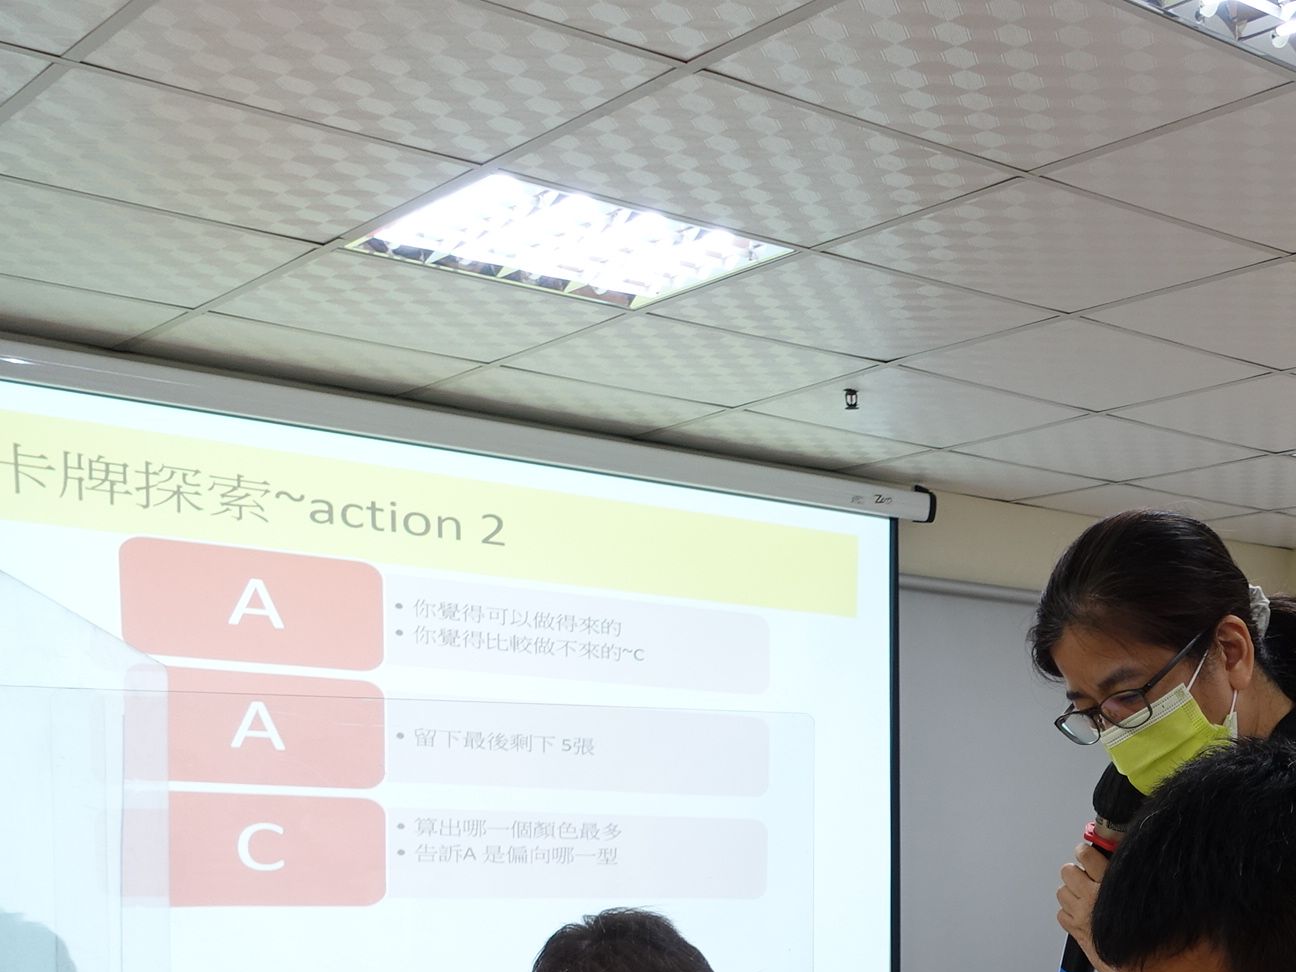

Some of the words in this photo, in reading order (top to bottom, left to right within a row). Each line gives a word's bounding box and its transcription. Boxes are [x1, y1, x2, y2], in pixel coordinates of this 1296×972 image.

[481, 513, 506, 546] 2
[228, 578, 285, 629] A
[231, 701, 285, 751] A
[238, 822, 285, 871] C
